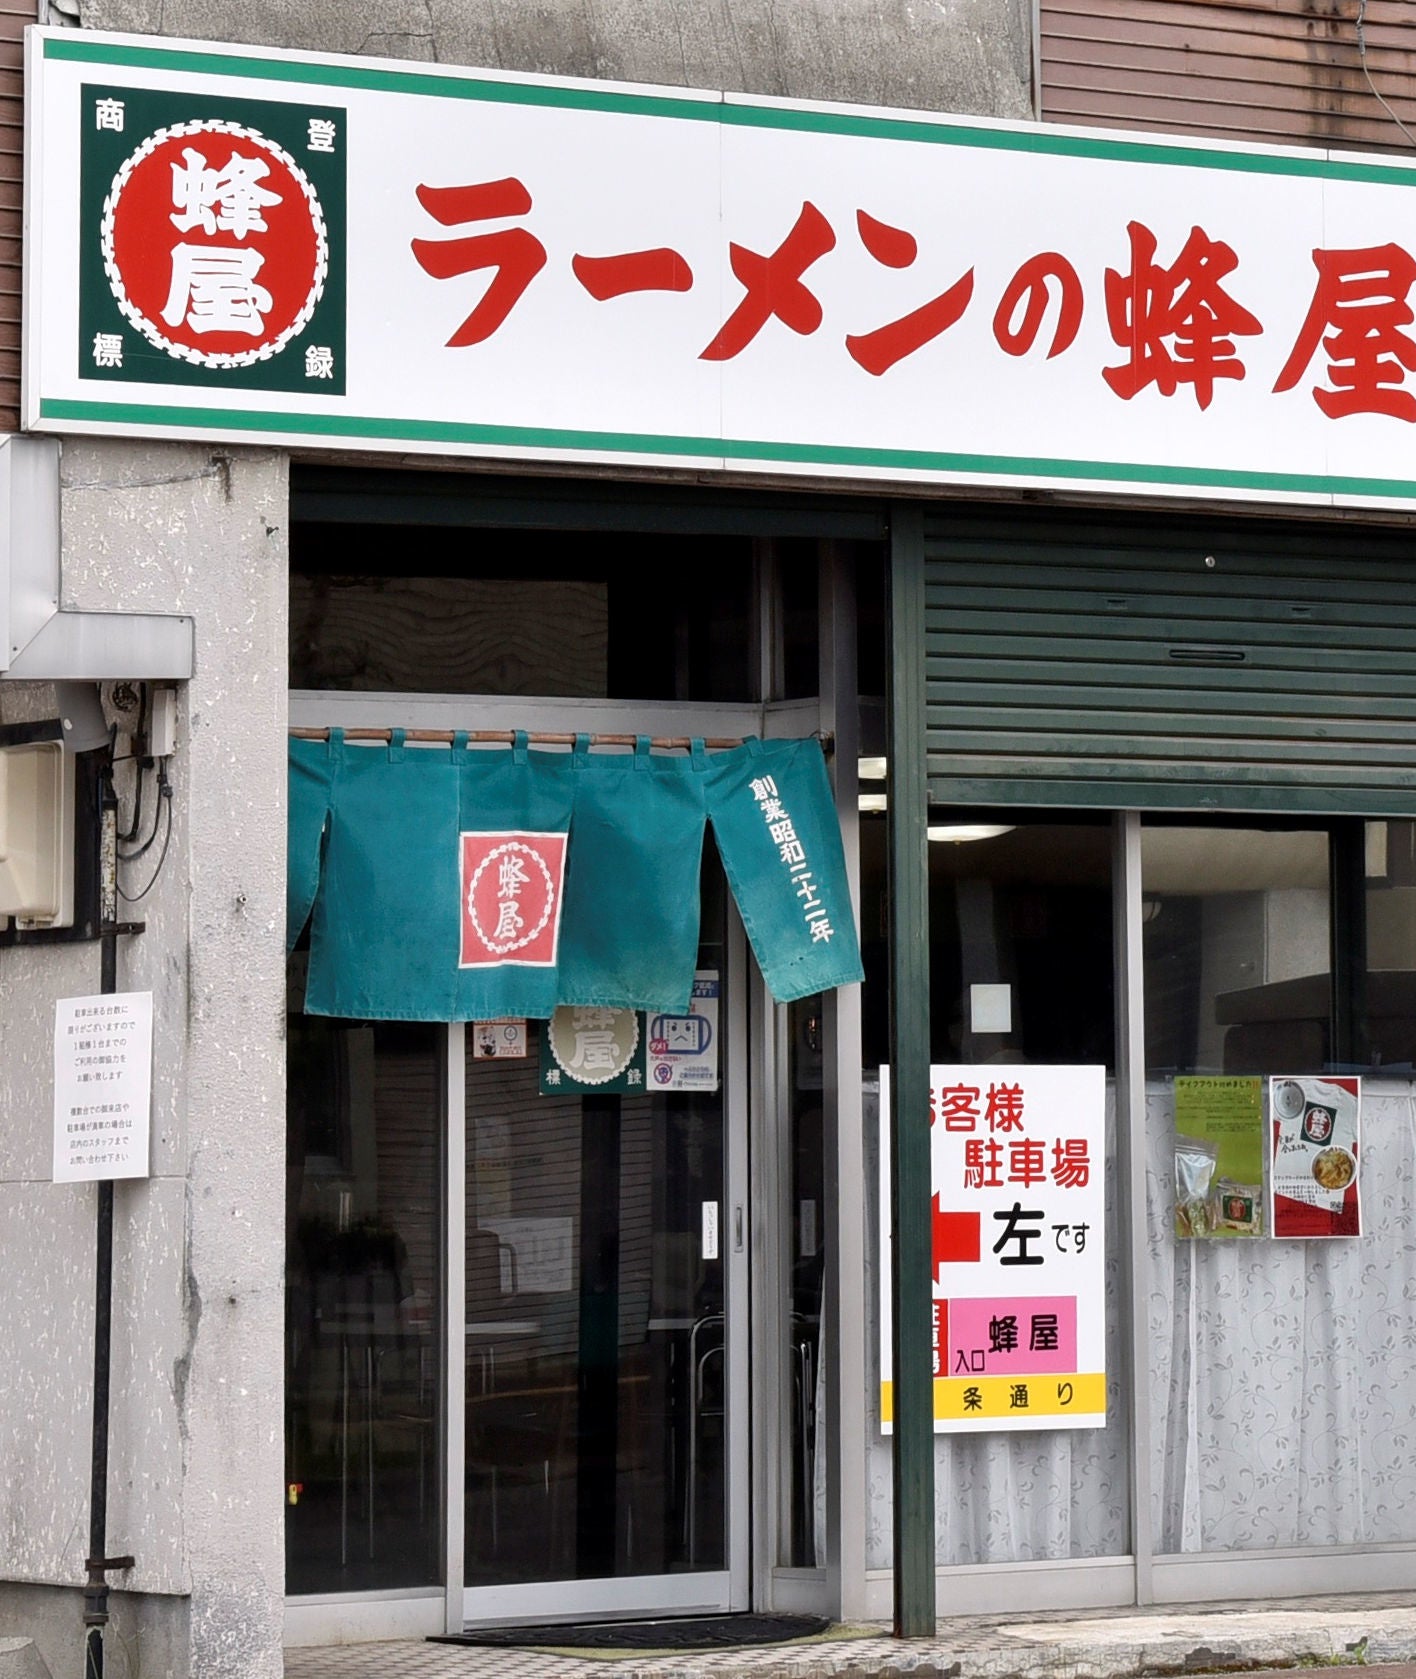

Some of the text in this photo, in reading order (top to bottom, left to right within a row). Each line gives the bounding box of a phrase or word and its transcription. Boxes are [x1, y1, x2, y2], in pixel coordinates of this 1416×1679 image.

[95, 97, 125, 132] 商
[306, 118, 336, 153] 登
[159, 147, 283, 336] 蜂屋
[92, 332, 124, 368] 標
[304, 344, 334, 380] 録
[749, 775, 834, 943] 創業昭和二十二年
[492, 855, 531, 940] 蜂屋
[930, 1083, 1025, 1132] 客様
[964, 1138, 1090, 1189] 駐車場
[988, 1314, 1059, 1354] 蜂屋
[955, 1349, 986, 1373] 入口
